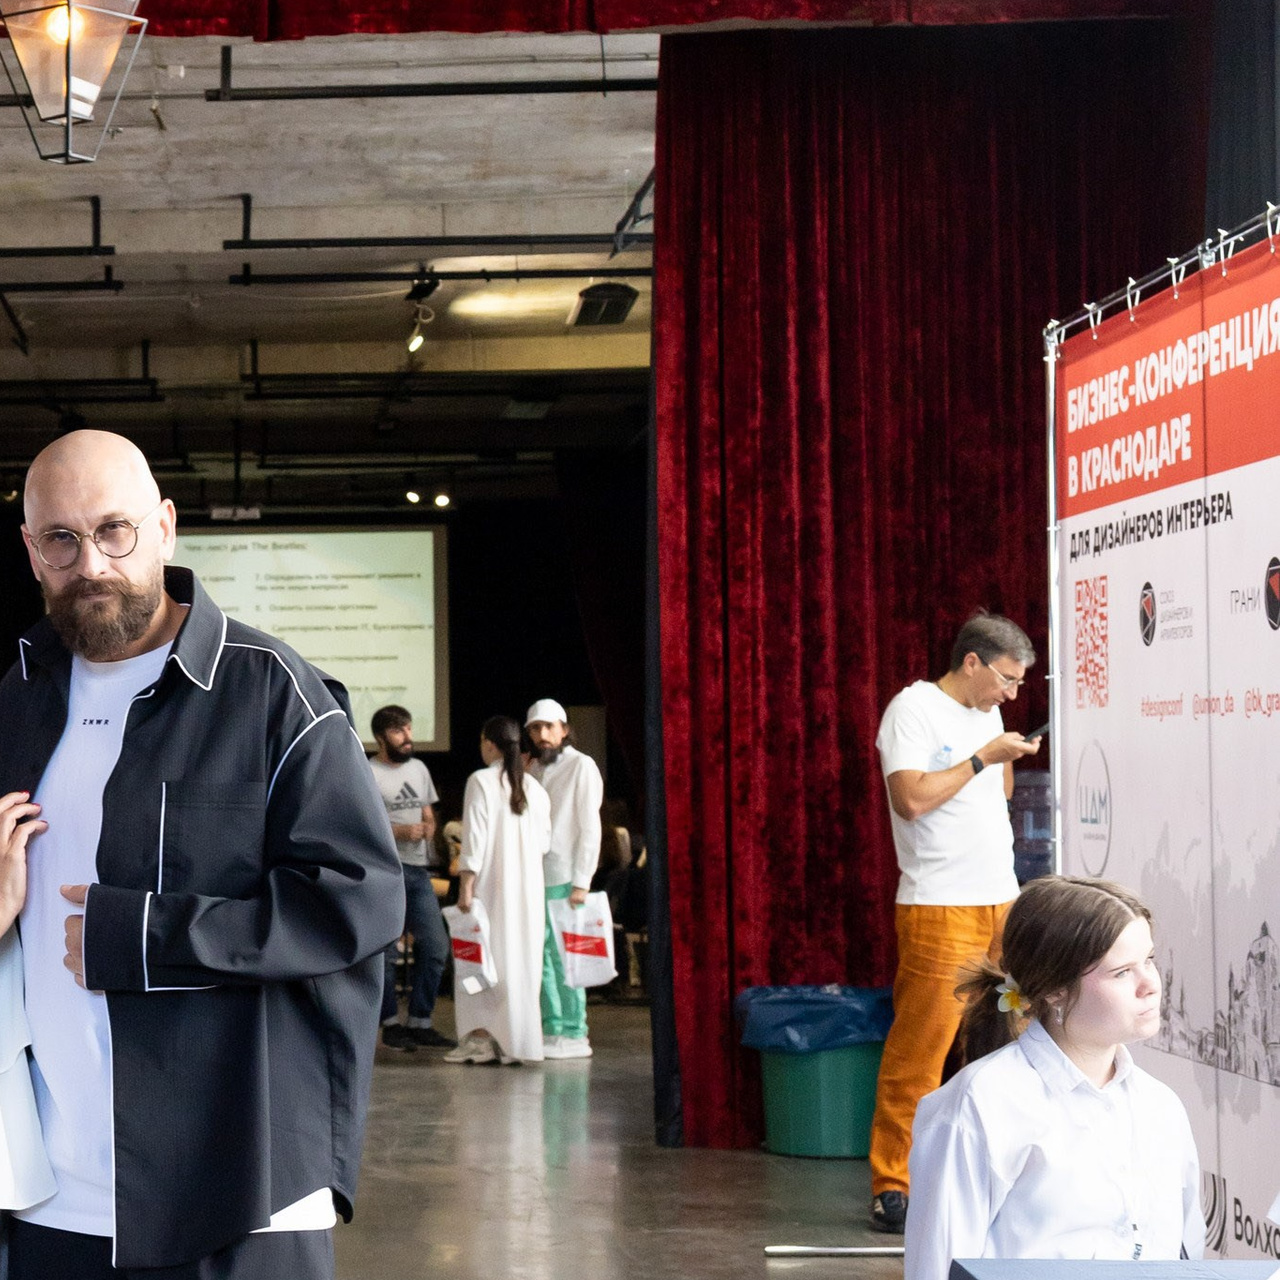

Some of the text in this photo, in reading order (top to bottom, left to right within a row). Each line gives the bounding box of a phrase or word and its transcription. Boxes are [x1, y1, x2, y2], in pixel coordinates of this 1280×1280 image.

[1067, 297, 1280, 433] БИЗНЕС-КОНФЕРЕНЦИЯ
[1068, 413, 1192, 497] В КРАСНОДАРЕ
[1070, 490, 1234, 563] ДЛЯ ДИЗАЙНЕРОВ ИНТЕРЬЕРА
[1230, 586, 1261, 614] ГРАНИ
